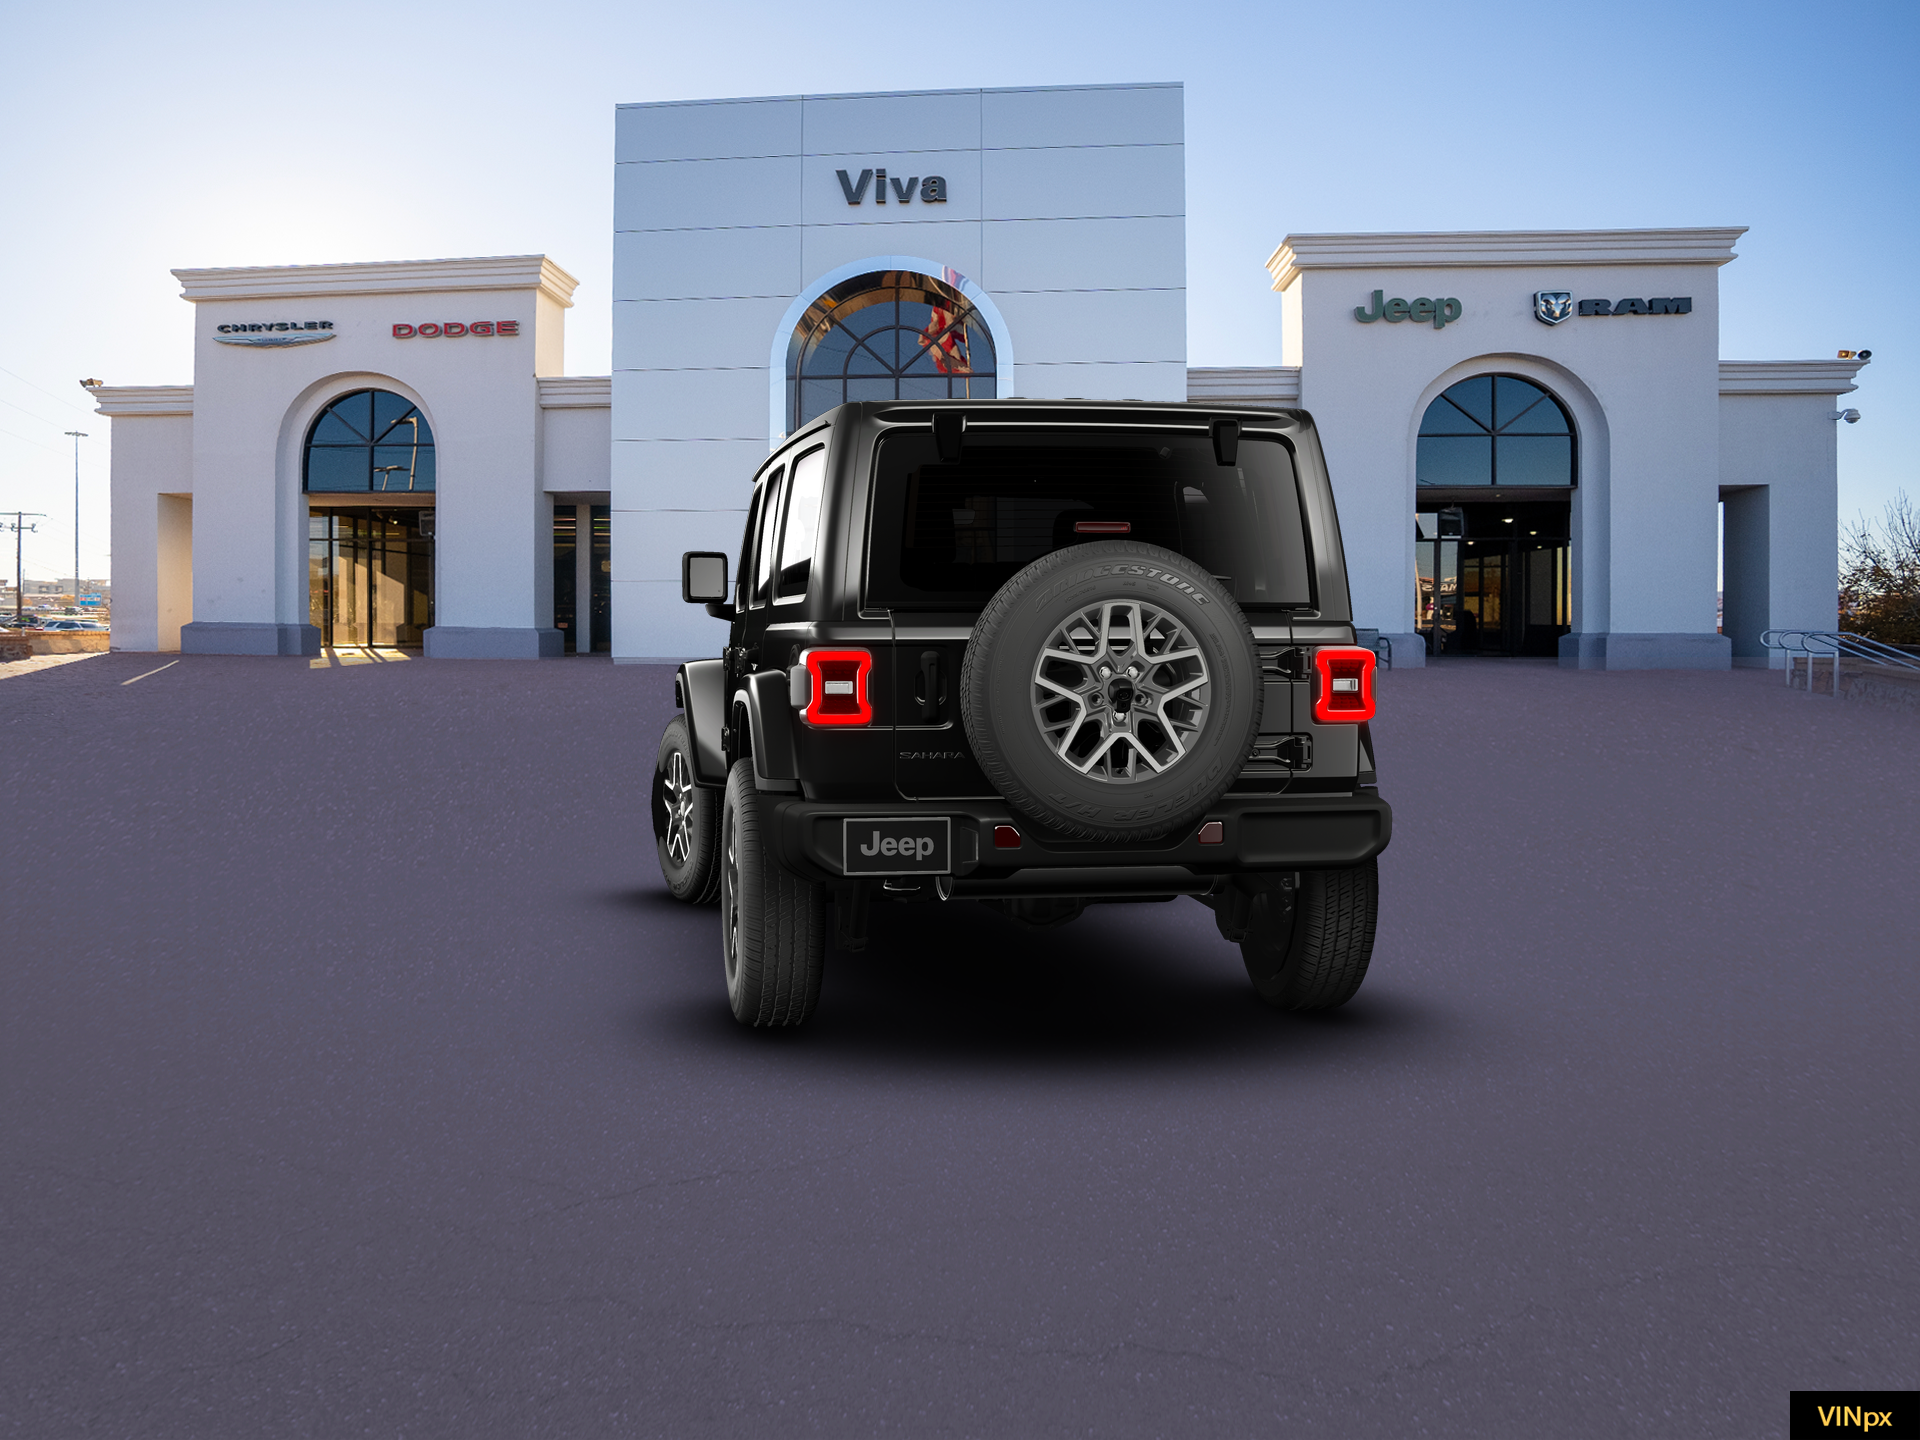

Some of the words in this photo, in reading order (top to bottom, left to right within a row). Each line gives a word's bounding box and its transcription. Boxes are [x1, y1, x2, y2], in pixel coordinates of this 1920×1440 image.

[835, 168, 948, 205] Viva
[1354, 289, 1462, 329] Jeep
[1578, 296, 1692, 316] RAM
[217, 320, 334, 334] CHRYSLER
[392, 320, 519, 338] DODGE
[899, 751, 966, 760] SAHARA
[860, 830, 935, 861] Jeep
